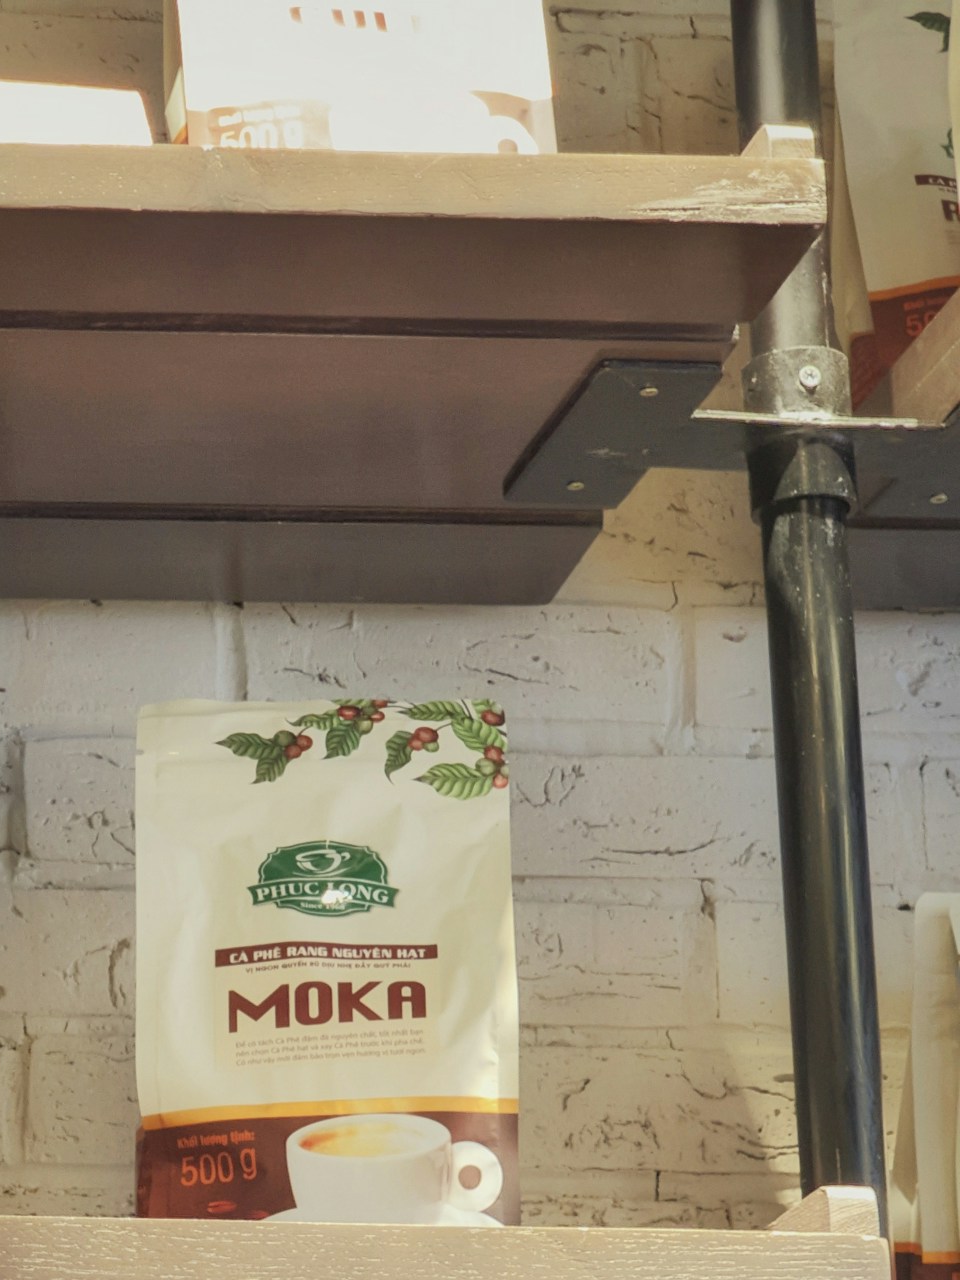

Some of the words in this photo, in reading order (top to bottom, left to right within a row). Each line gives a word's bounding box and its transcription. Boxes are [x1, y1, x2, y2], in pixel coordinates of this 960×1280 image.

[255, 882, 320, 902] PHUC
[229, 950, 248, 964] CÀ
[253, 946, 281, 961] PHÊ
[286, 946, 328, 957] RANG
[332, 947, 392, 958] NGUYÊN
[396, 948, 426, 960] HẠT
[228, 980, 427, 1033] MOKA
[180, 1151, 234, 1187] 500
[240, 1147, 257, 1180] g
